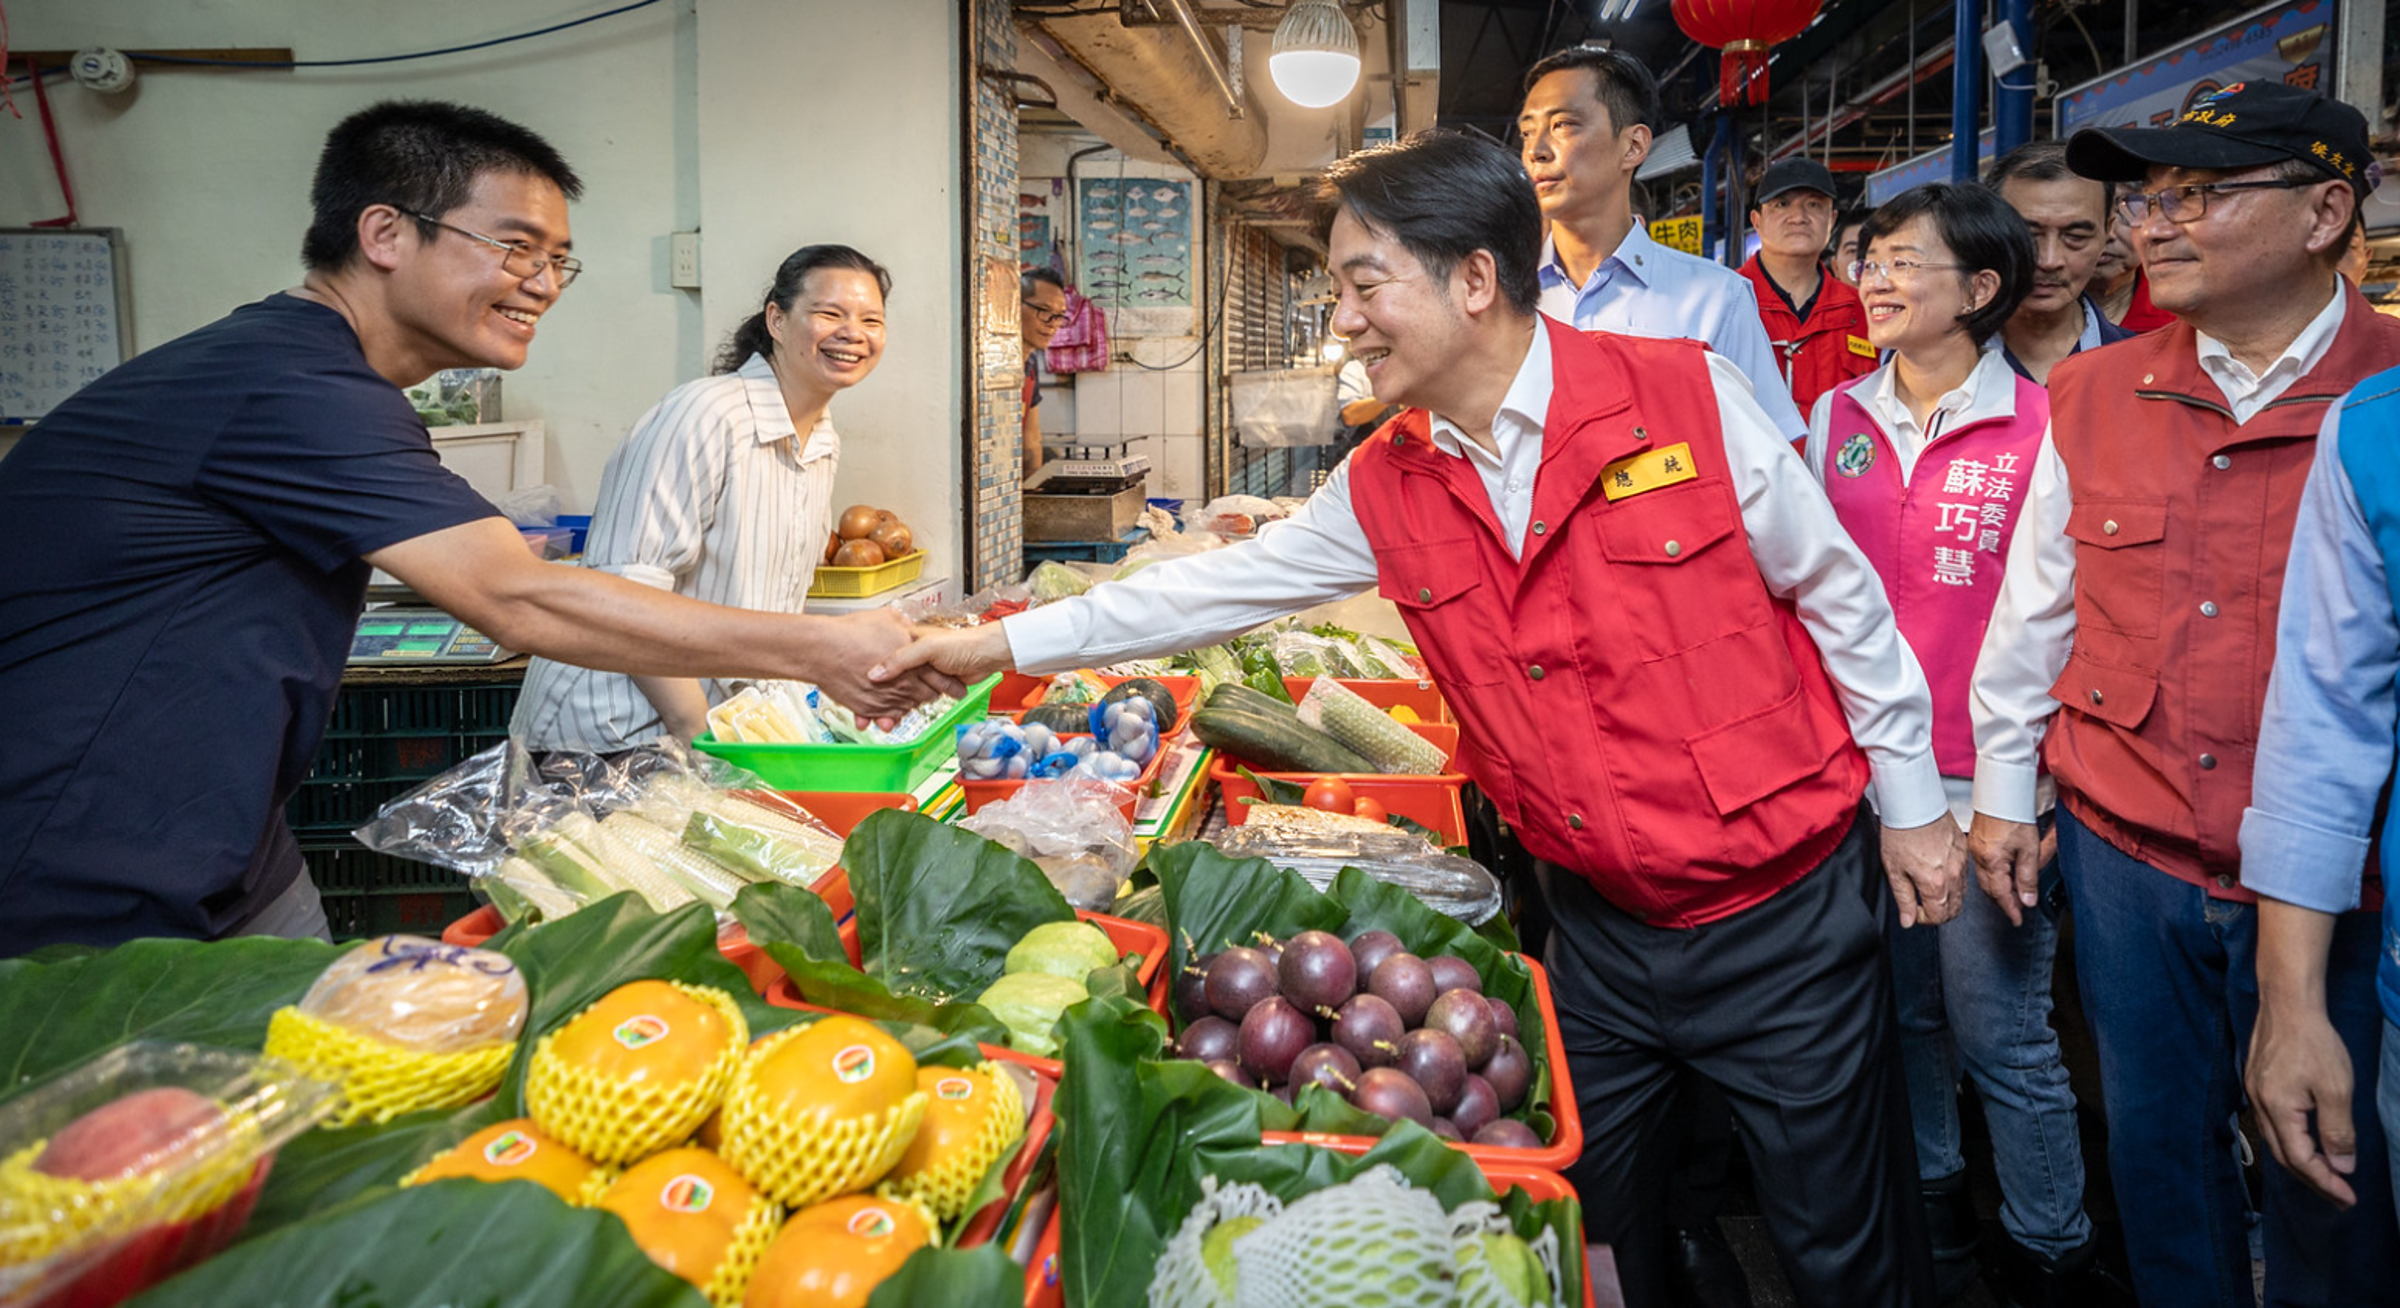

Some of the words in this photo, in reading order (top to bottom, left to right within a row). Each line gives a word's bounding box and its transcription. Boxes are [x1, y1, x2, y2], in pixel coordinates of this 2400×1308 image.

[2171, 109, 2237, 128] 市政府
[1655, 219, 1699, 245] 牛肉
[1615, 455, 1683, 488] 總統
[1978, 452, 2019, 553] 立法委員
[1933, 459, 1989, 587] 蘇巧慧
